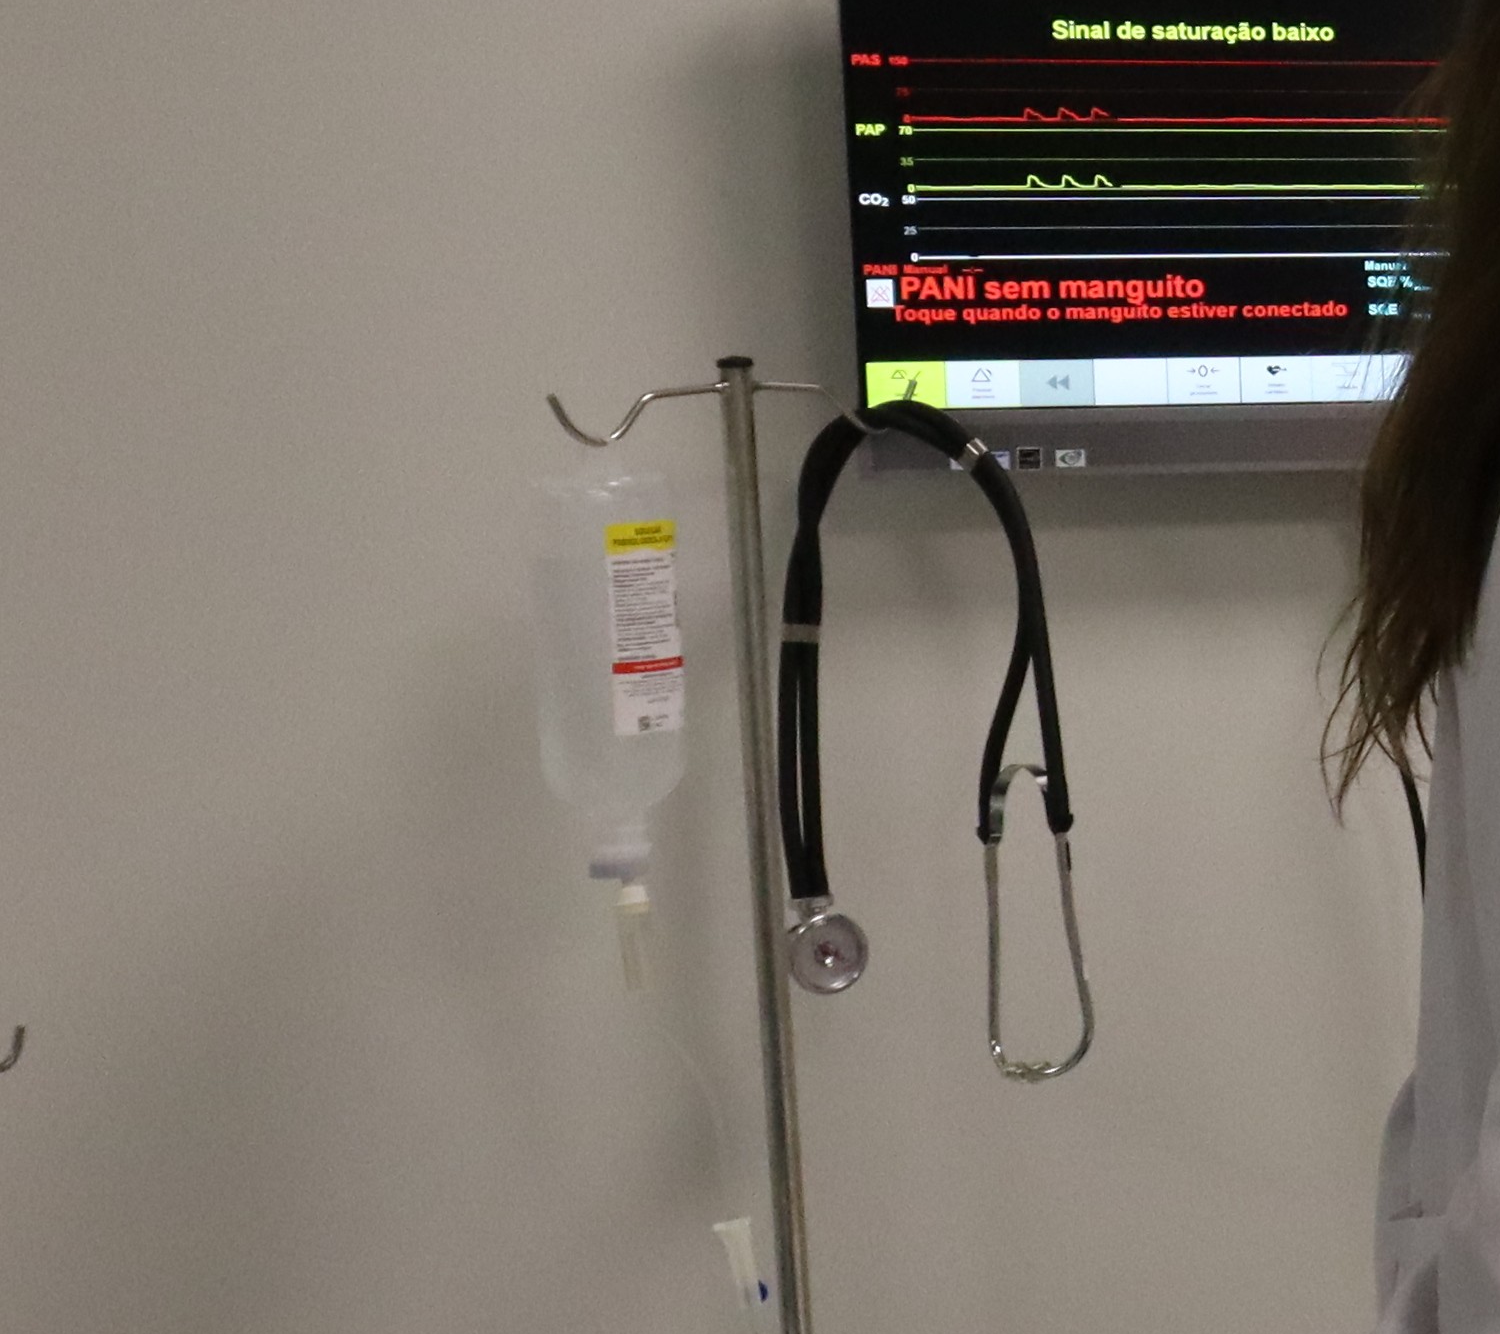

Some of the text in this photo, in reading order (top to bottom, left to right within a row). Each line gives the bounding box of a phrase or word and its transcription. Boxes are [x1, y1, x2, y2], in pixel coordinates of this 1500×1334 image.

[1051, 19, 1335, 44] Sinal de saturação baixo
[850, 53, 881, 66] PAS
[855, 123, 913, 136] PAP 70
[907, 183, 916, 193] 0
[901, 194, 917, 205] 50
[903, 225, 918, 236] 25
[910, 252, 919, 262] 0
[900, 274, 1205, 305] PANI sem manguito
[894, 300, 1348, 326] Toque quando o manguito estiver conectado
